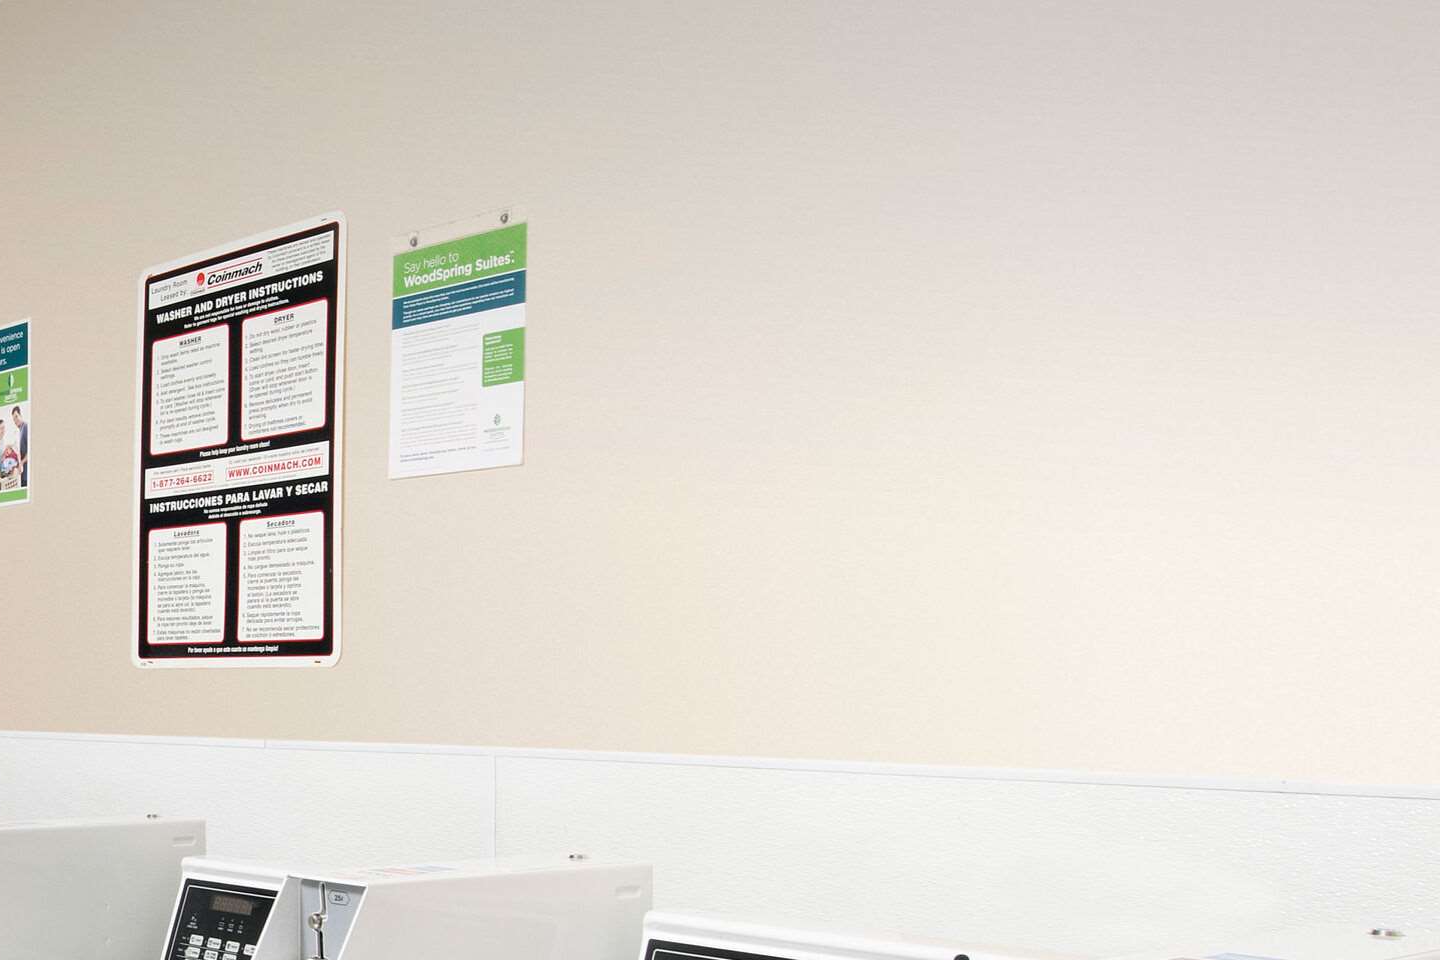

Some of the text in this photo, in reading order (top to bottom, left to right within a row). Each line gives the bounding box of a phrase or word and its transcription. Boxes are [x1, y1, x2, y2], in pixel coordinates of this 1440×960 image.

[404, 252, 459, 274] Say hello to
[208, 262, 262, 286] Coinmach
[404, 262, 472, 288] WoodSpring
[156, 306, 192, 324] WASHER
[194, 300, 214, 316] AND
[216, 292, 247, 310] DRYER
[248, 270, 324, 300] INSTRUCTIONS
[274, 312, 294, 324] DRYER
[7, 344, 21, 353] open
[180, 336, 202, 346] WASHER
[228, 457, 322, 478] WWW.COINMACH.COM
[150, 495, 223, 514] INSTRUCCIONES
[226, 490, 250, 504] PARA
[252, 486, 284, 500] LAVAR
[286, 486, 293, 496] Y
[295, 481, 328, 496] SECAR
[266, 520, 295, 528] Secadora
